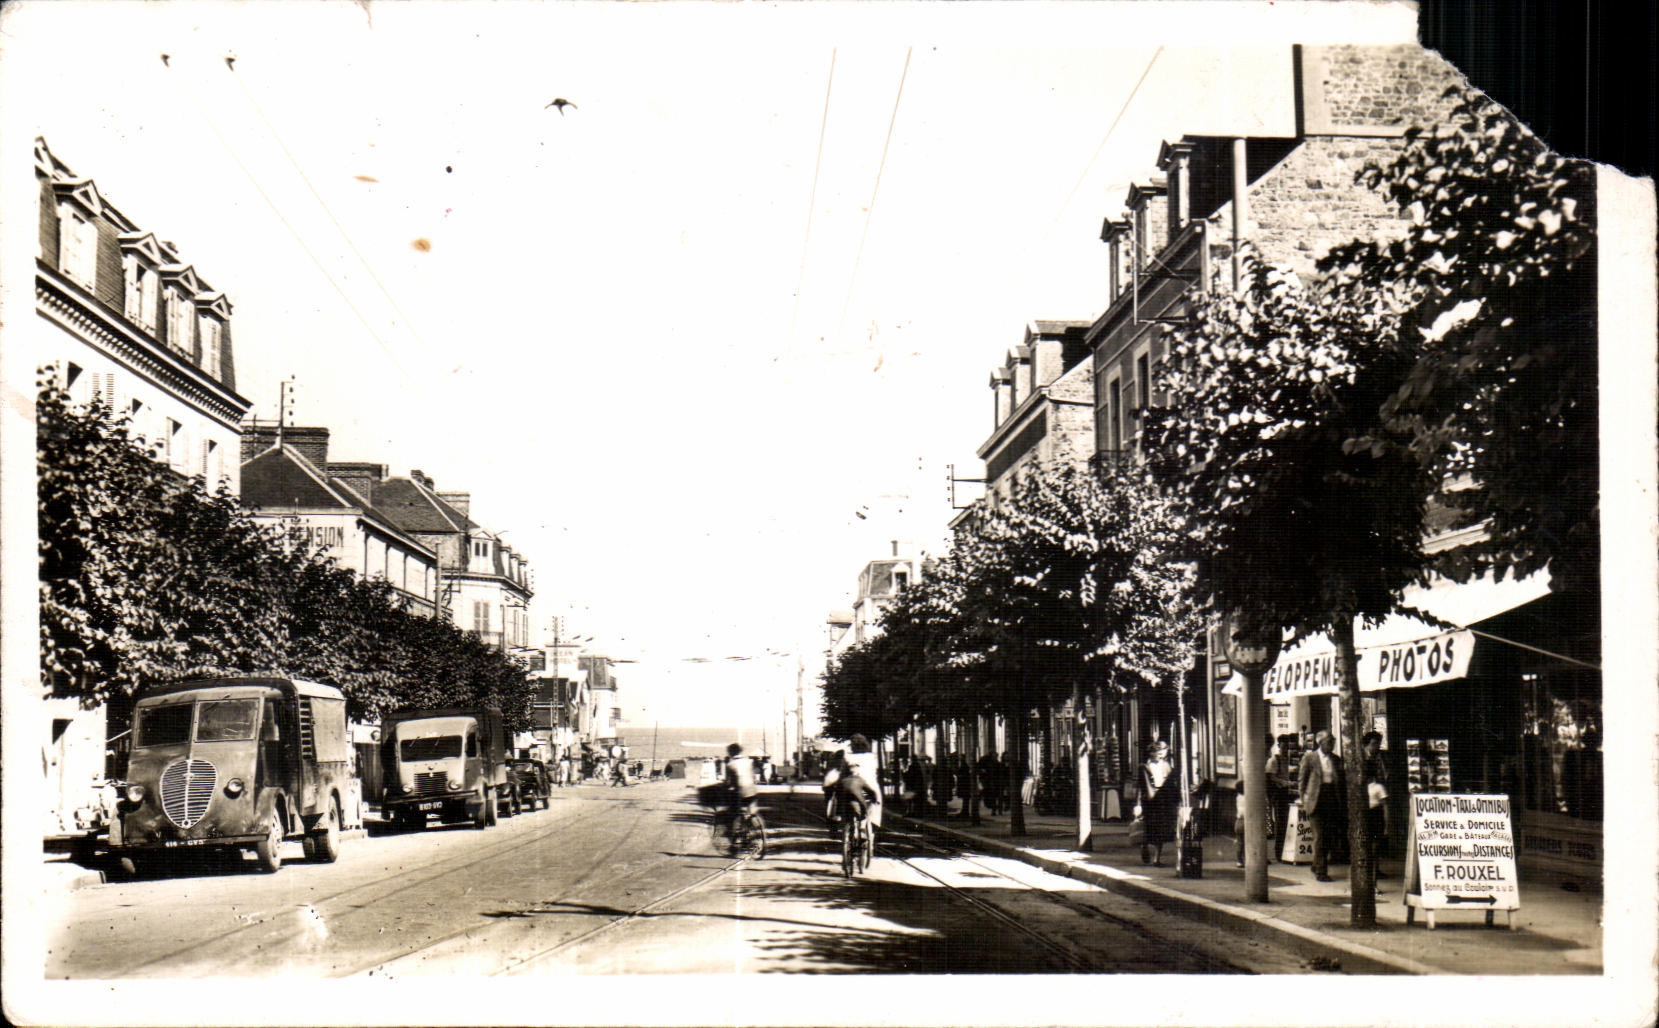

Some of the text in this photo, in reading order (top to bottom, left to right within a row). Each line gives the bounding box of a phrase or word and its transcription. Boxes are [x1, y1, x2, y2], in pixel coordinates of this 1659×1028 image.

[1378, 637, 1455, 683] PHOTOS
[1423, 819, 1458, 830] SERVICE
[1467, 819, 1505, 830] DOMICILE
[1418, 843, 1462, 859] EXCURSIONS
[1473, 843, 1514, 860] DISTANCES
